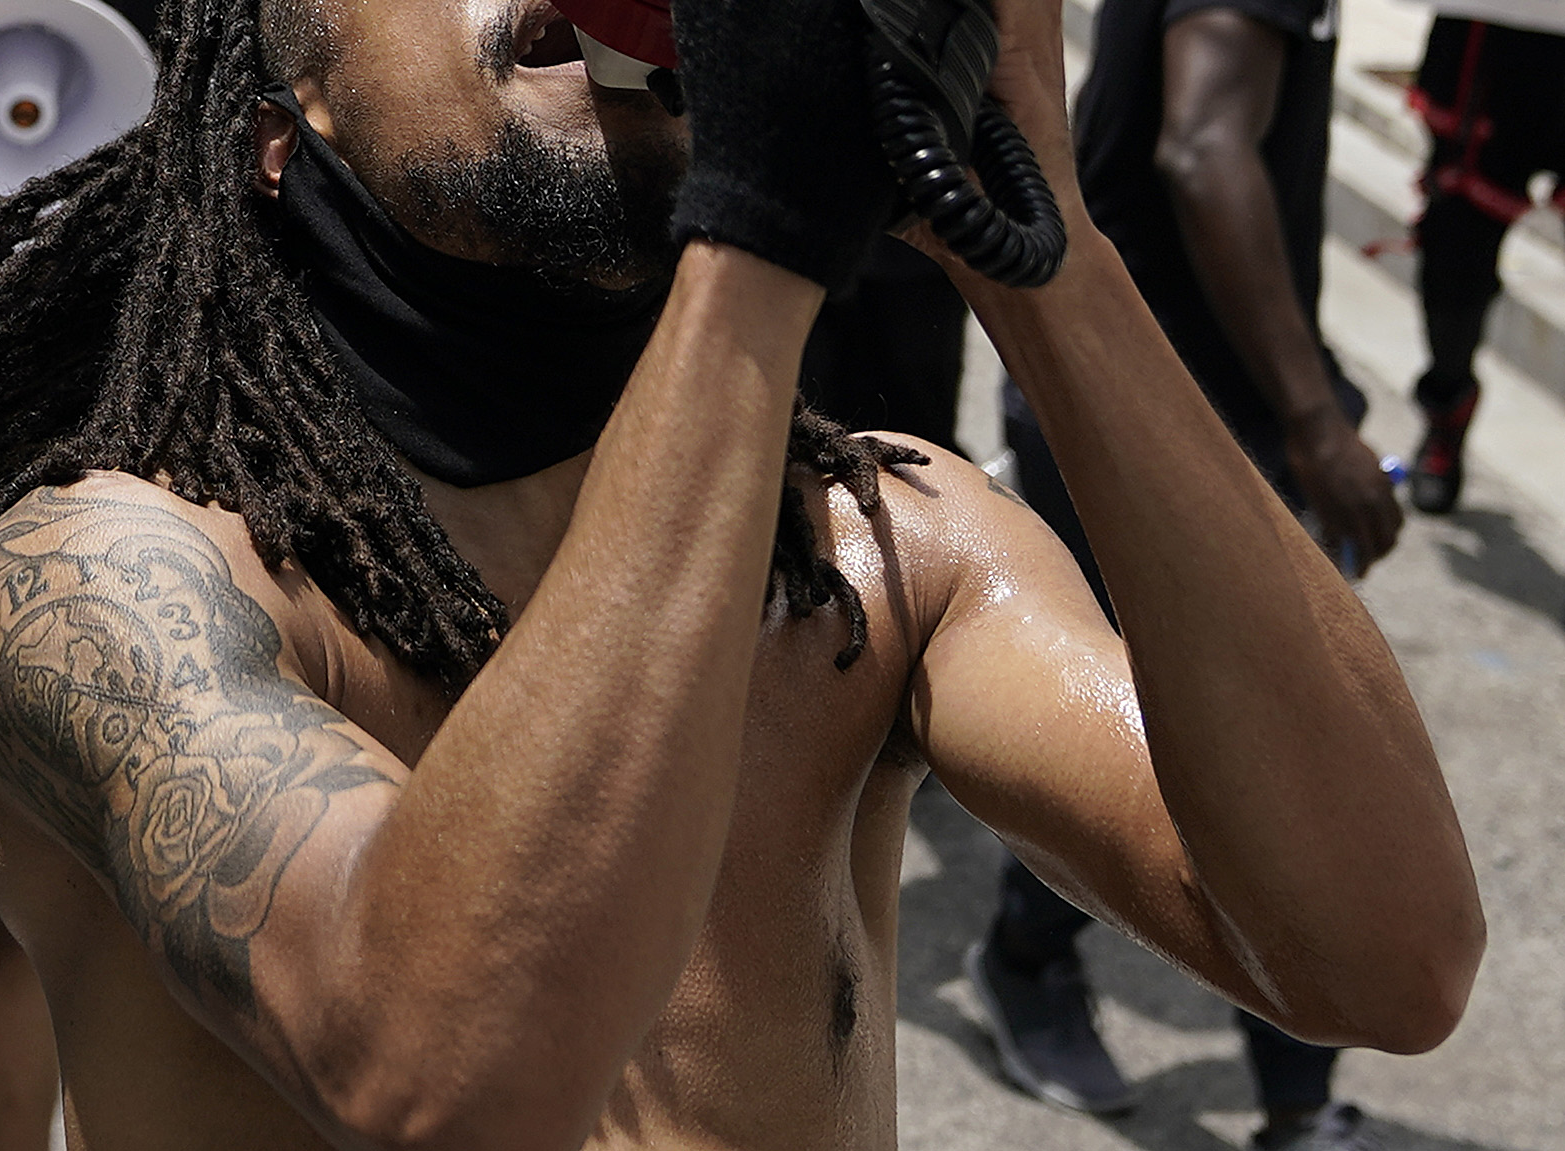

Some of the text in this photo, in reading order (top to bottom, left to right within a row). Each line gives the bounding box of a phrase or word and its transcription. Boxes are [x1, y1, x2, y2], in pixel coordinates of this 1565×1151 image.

[1, 565, 50, 616] 12
[157, 602, 201, 641] 3
[171, 652, 213, 695] 4
